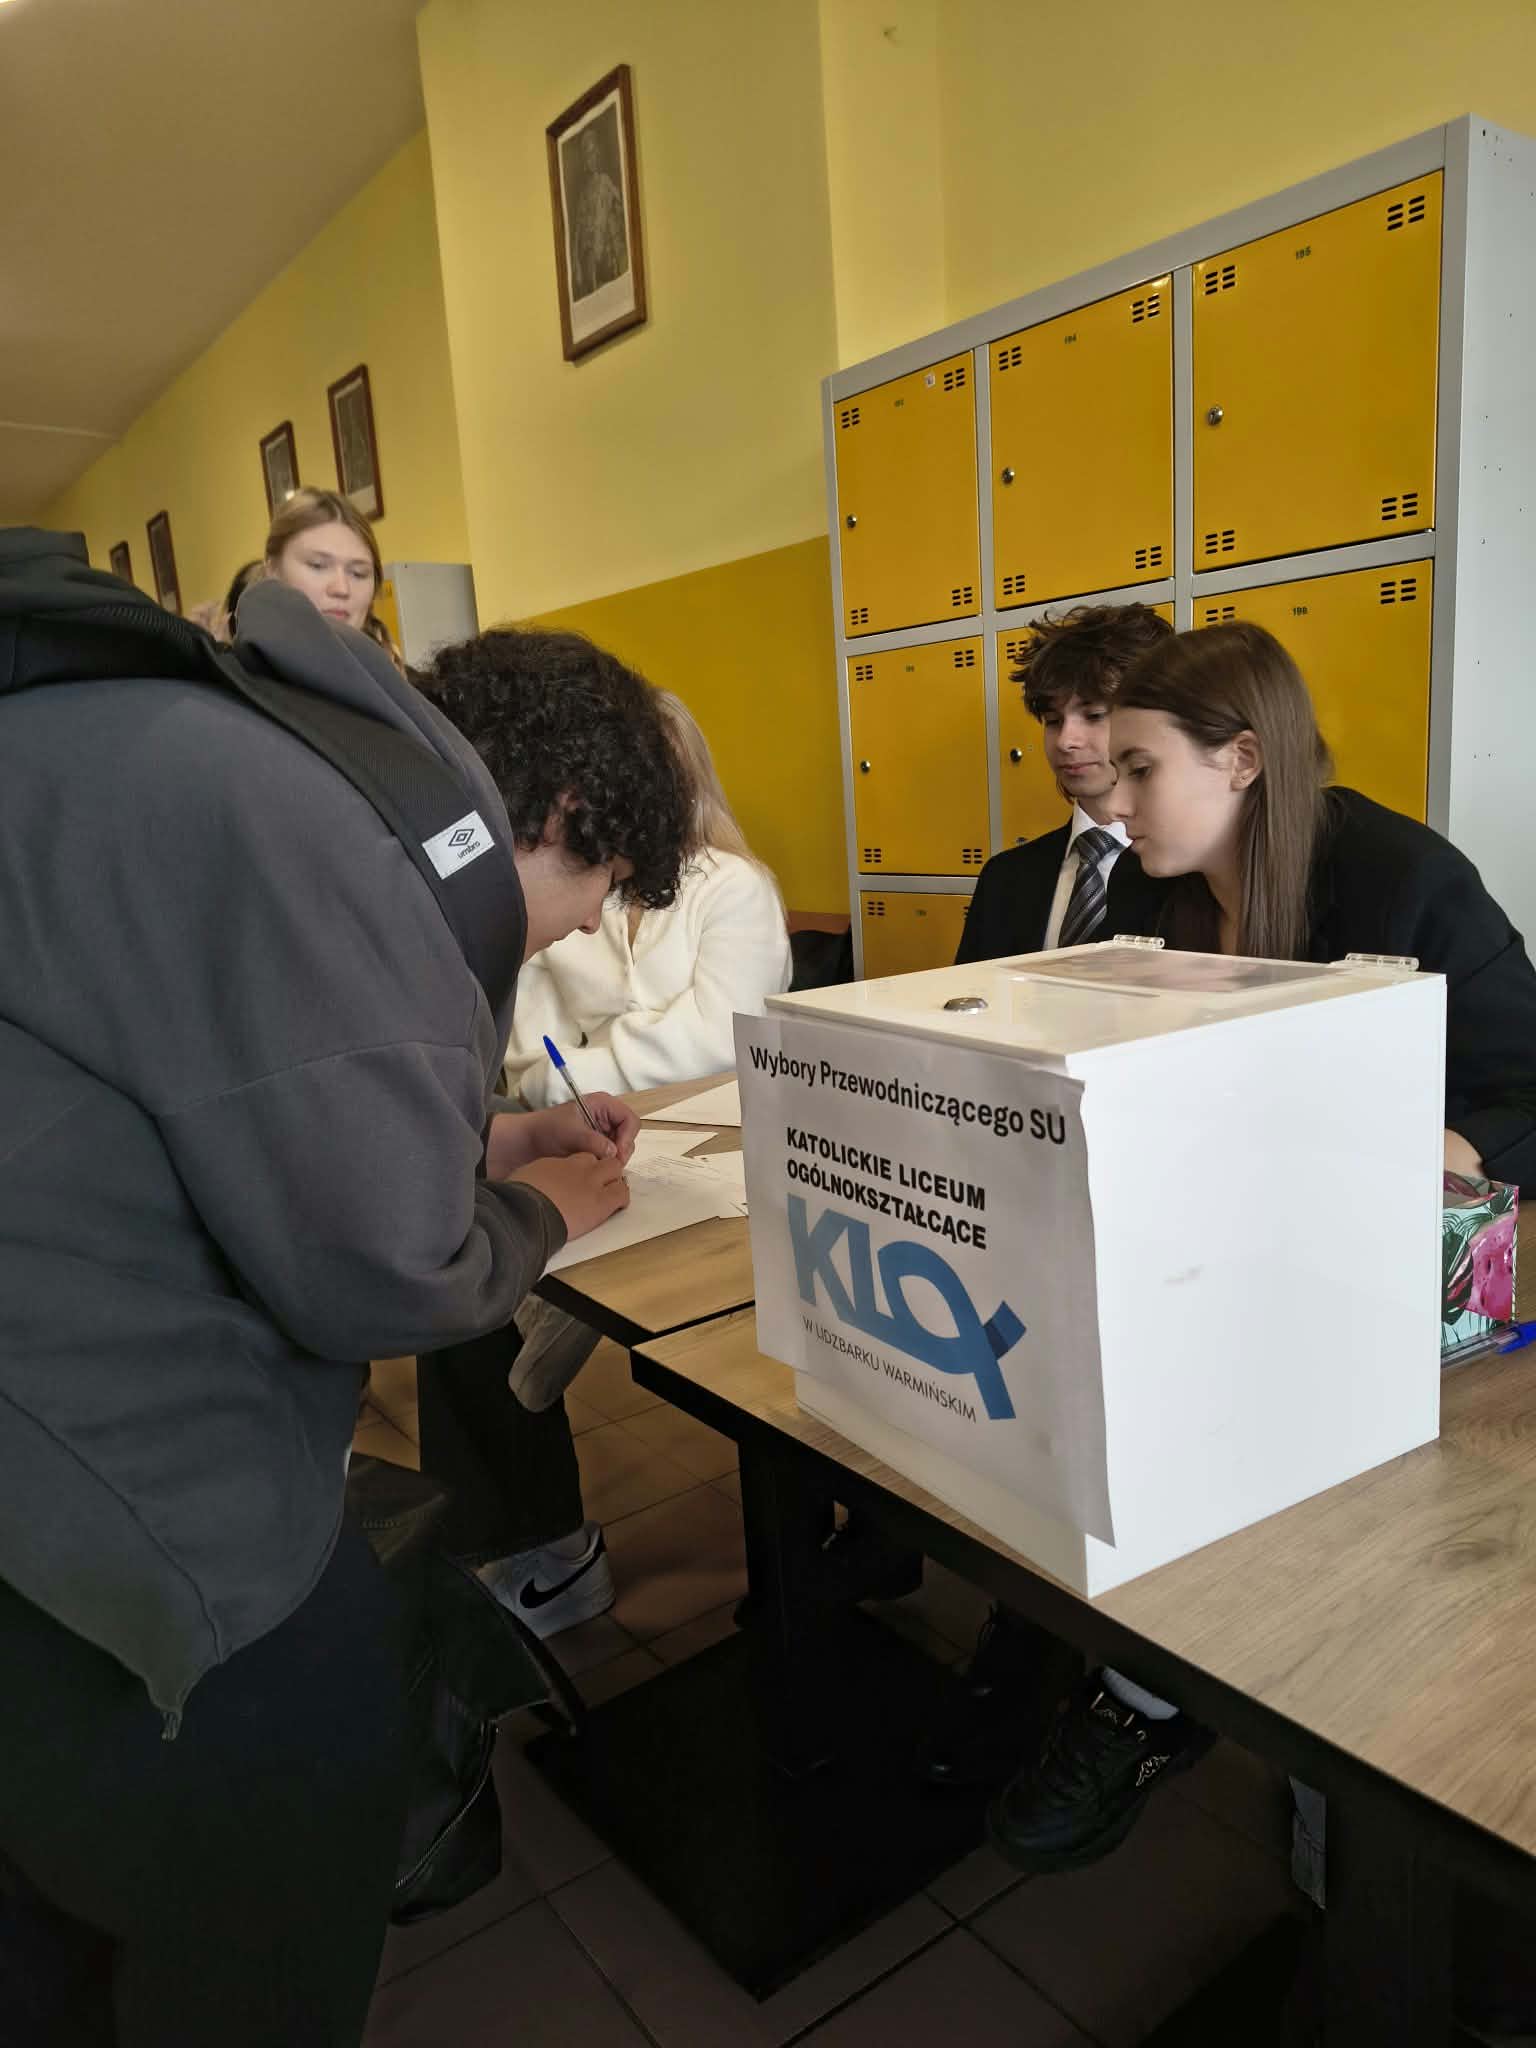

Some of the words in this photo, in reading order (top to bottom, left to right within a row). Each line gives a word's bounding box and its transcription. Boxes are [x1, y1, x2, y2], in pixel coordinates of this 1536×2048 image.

[457, 841, 481, 859] umbro
[749, 1045, 816, 1087] Wybory
[820, 1060, 1024, 1137] Przewodniczącego
[1030, 1108, 1066, 1145] SU
[787, 1126, 892, 1181] KATOLICKIE
[899, 1163, 986, 1212] LICEUM
[787, 1158, 987, 1250] OGÓLNOKSZTAŁCĄCE
[802, 1315, 814, 1333] W
[815, 1324, 880, 1371] LIDZBARKU
[882, 1360, 977, 1423] WARMIŃSKIM
